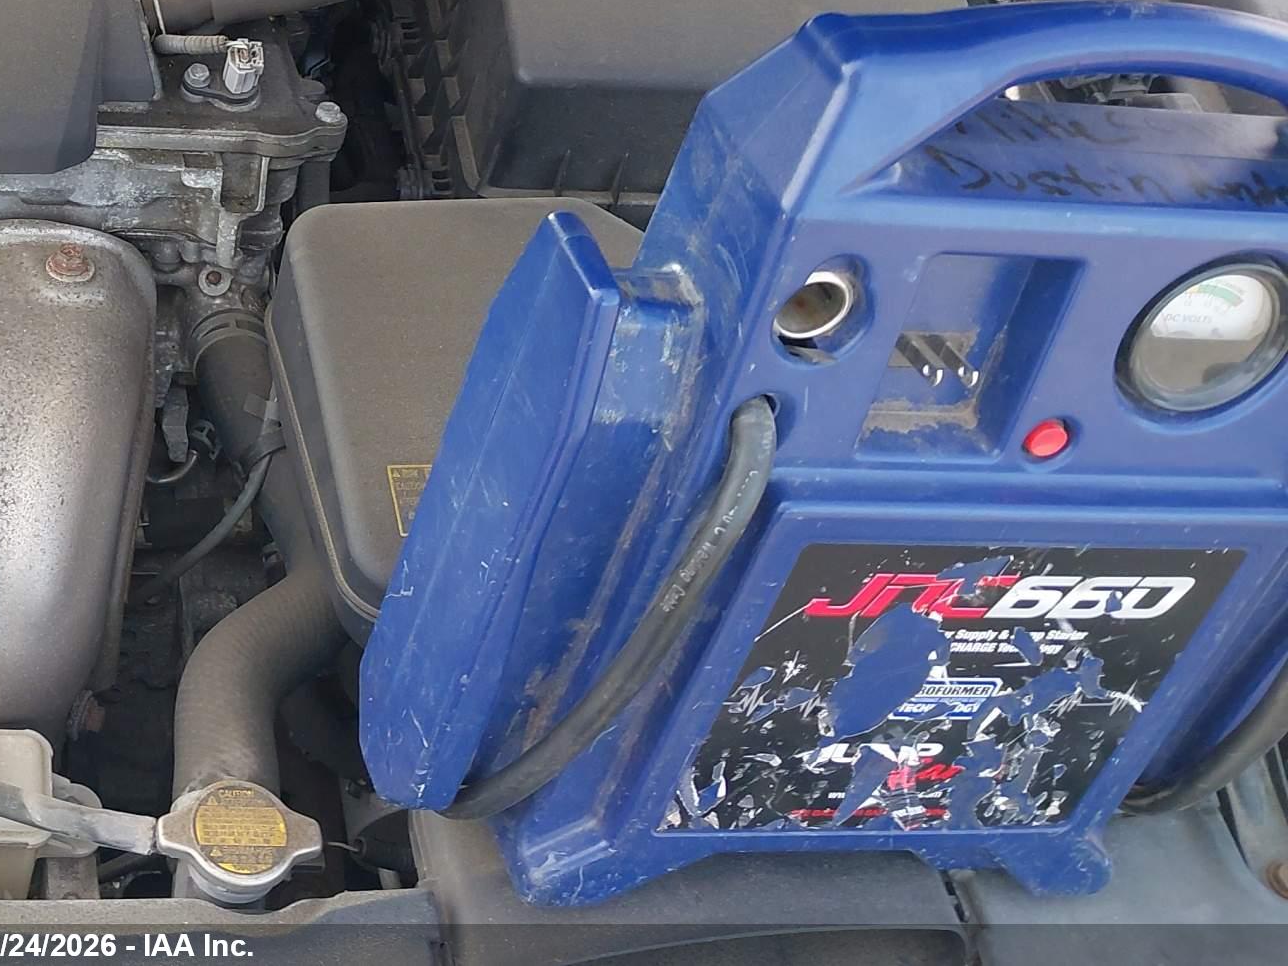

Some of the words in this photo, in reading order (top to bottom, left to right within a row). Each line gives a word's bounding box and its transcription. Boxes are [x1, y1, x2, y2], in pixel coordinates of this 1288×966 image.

[955, 629, 998, 642] Supply
[998, 630, 1010, 640] &
[1046, 630, 1089, 642] Starter
